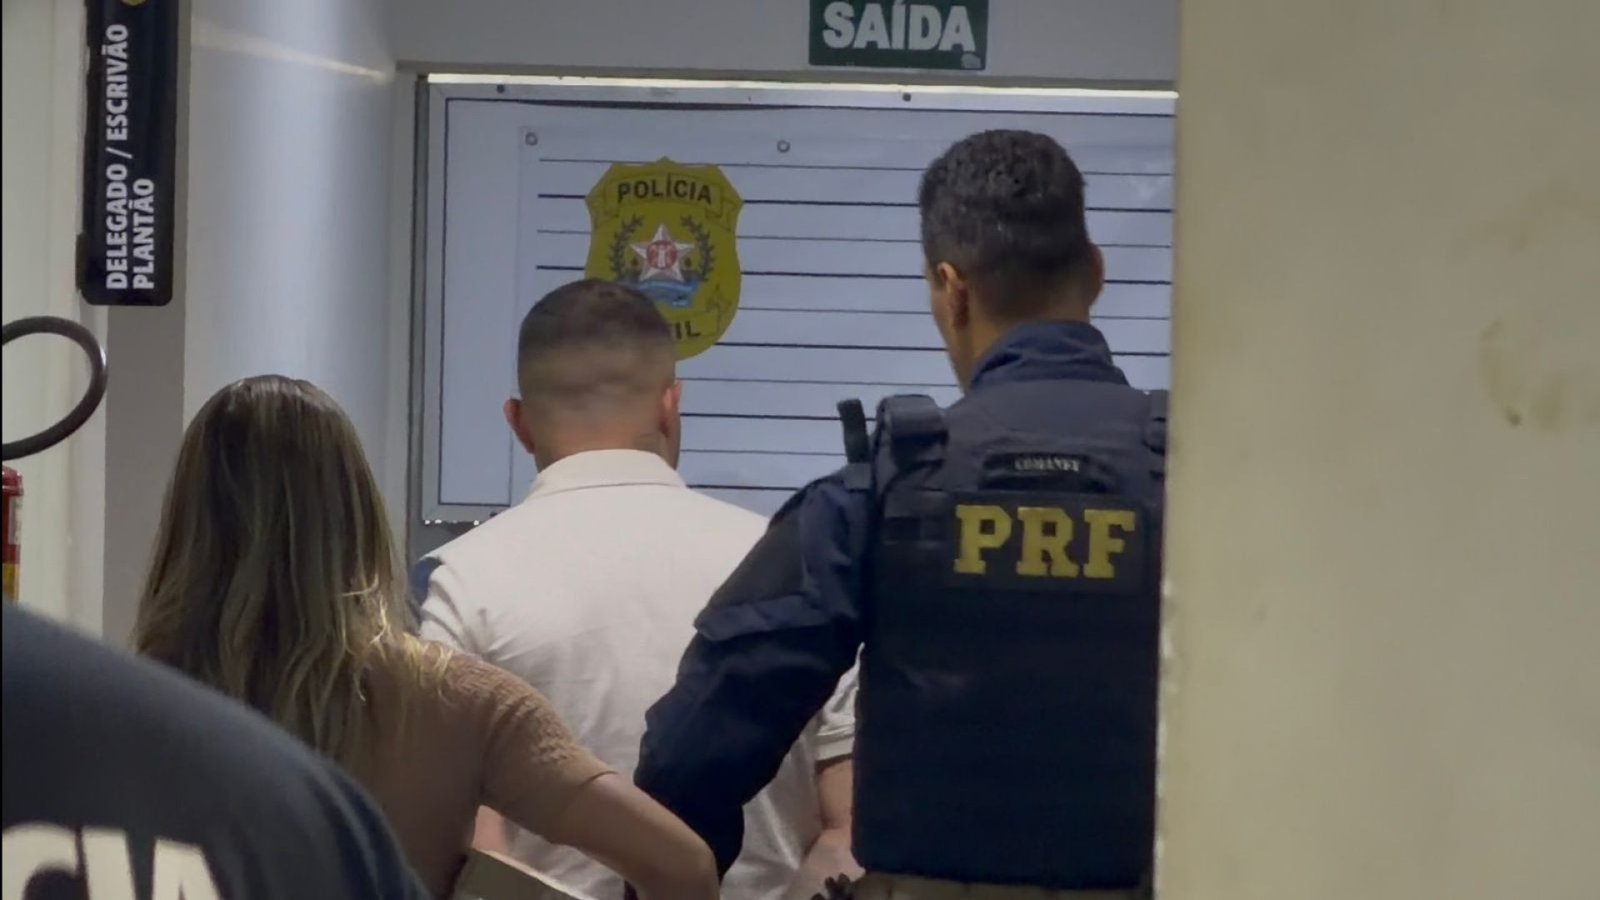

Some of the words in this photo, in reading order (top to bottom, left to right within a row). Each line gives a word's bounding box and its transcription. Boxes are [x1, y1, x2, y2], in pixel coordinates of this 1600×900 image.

[822, 0, 977, 52] SAÍDA
[101, 23, 128, 140] ESCRIVÃO
[106, 146, 133, 159] /
[617, 174, 712, 205] POLÍCIA
[106, 163, 128, 289] DELEGADO
[128, 178, 154, 289] PLANTÃO
[953, 504, 1136, 578] PRF
